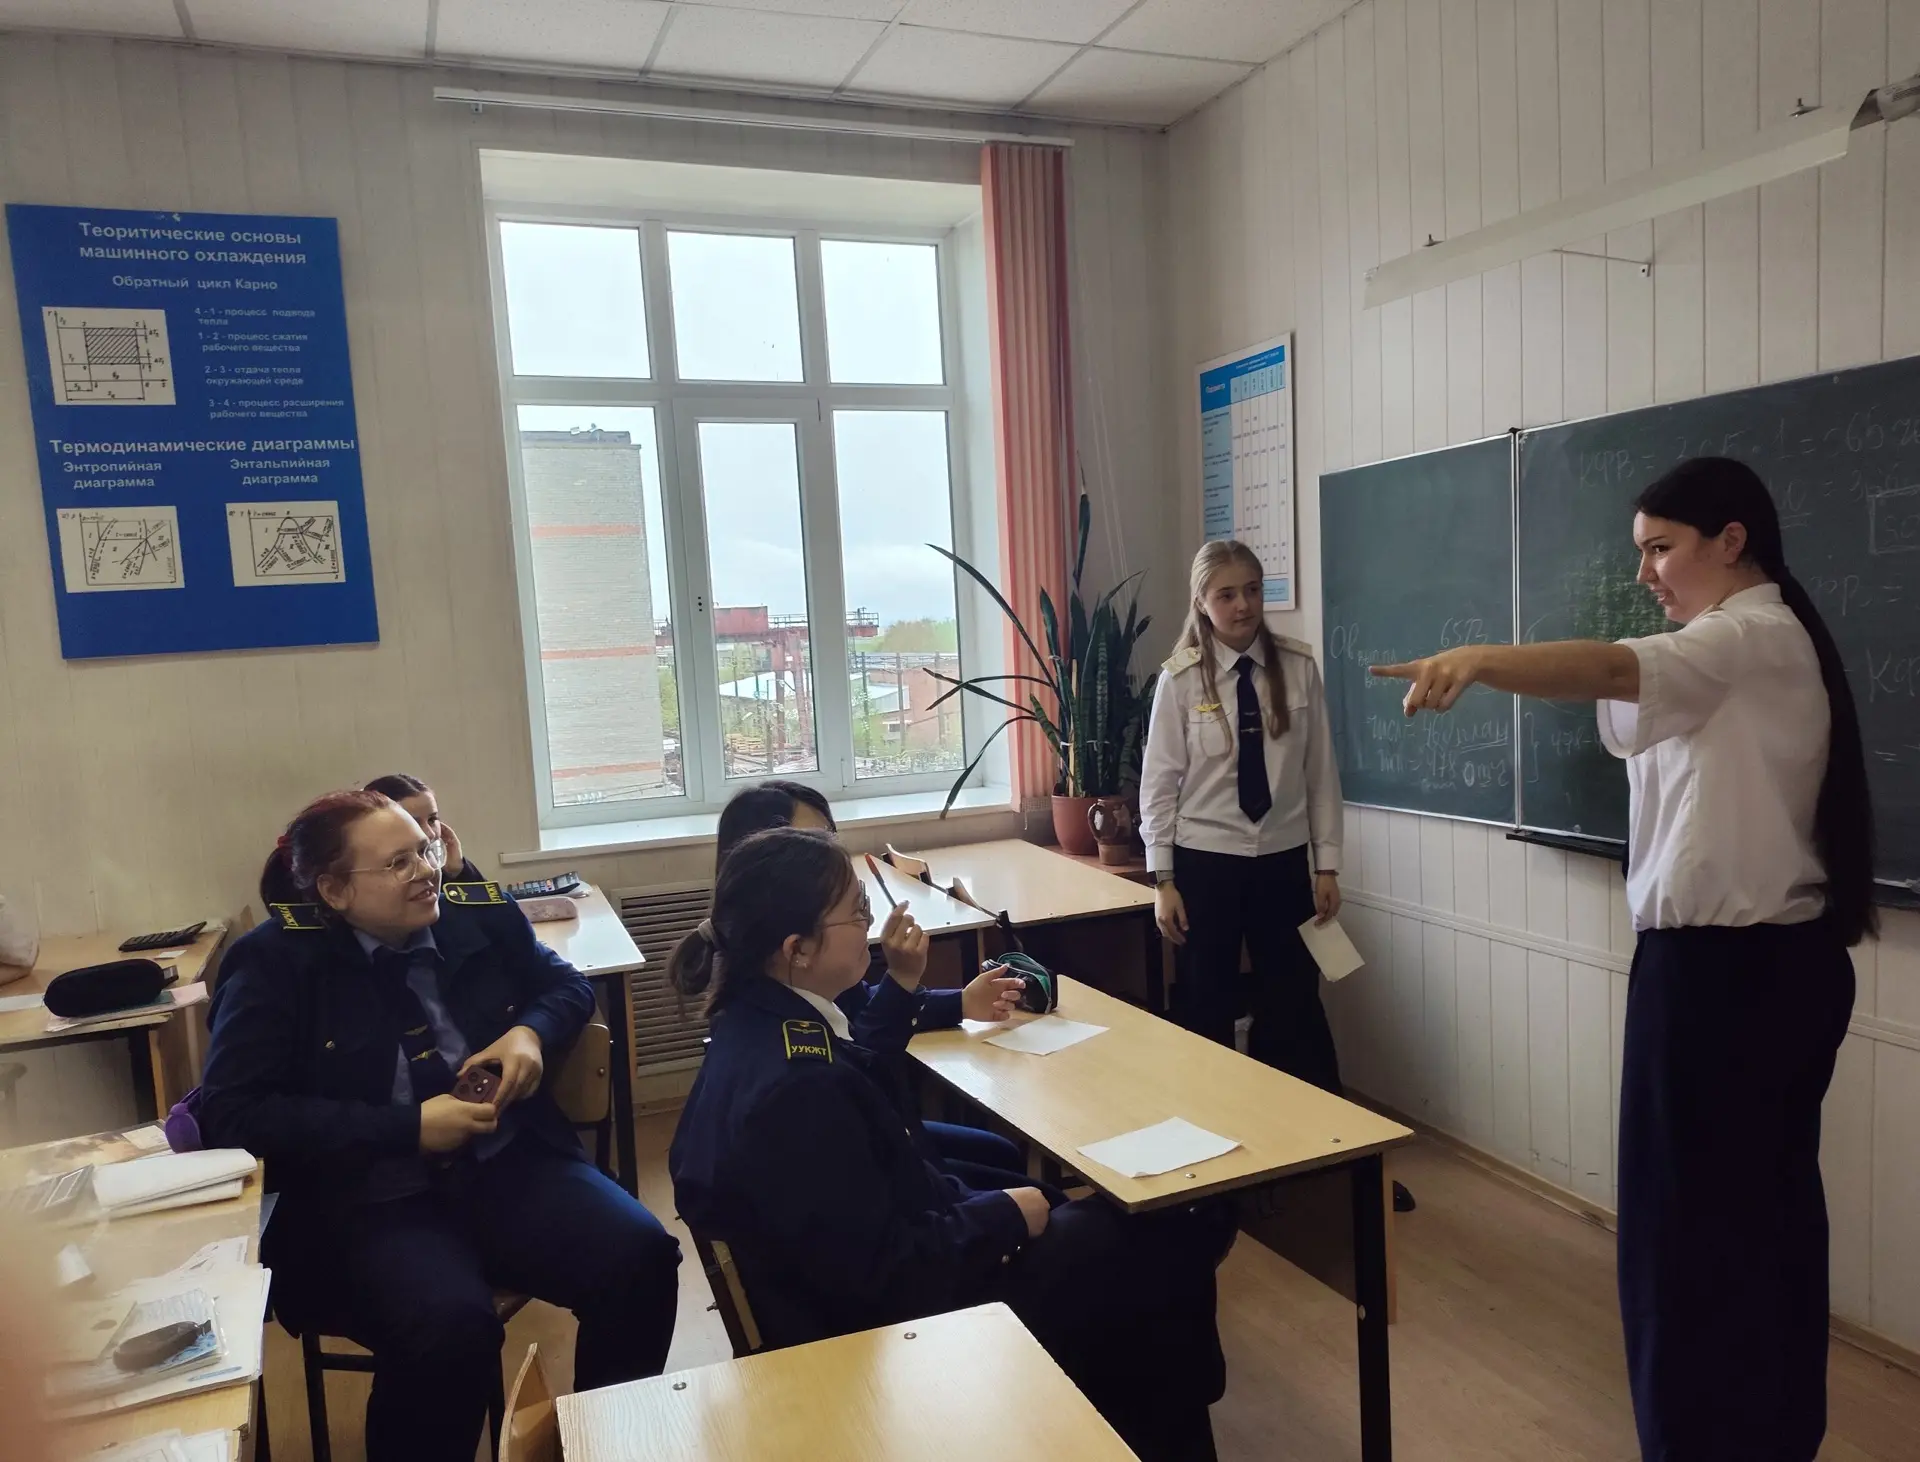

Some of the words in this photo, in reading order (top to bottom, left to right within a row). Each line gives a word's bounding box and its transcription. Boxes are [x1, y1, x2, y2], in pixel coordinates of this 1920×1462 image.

[78, 221, 226, 242] Теоритические
[230, 229, 301, 245] основы
[78, 245, 189, 261] машинного
[194, 249, 307, 267] охлаждения
[111, 274, 189, 289] Обратный
[197, 279, 231, 290] цикл
[235, 277, 278, 291] Карно
[194, 307, 201, 315] 4
[224, 308, 268, 318] процесс
[272, 309, 316, 318] подвода
[213, 331, 219, 340] 2
[227, 333, 270, 342] процесс
[272, 333, 308, 341] сжатия
[201, 343, 249, 353] рабочего
[251, 344, 301, 353] вещества
[204, 365, 210, 374] 2
[219, 365, 226, 374] 3
[234, 367, 270, 375] отдача
[205, 375, 272, 386] окружающей
[273, 377, 304, 386] среде
[208, 398, 215, 407] 3
[223, 399, 230, 407] 4
[238, 400, 281, 409] процесс
[282, 400, 345, 409] расширения
[209, 410, 257, 420] рабочего
[259, 410, 308, 419] вещества
[49, 438, 247, 456] Термодинамические
[251, 437, 355, 453] диаграммы
[63, 460, 162, 474] Энтропийная
[229, 457, 330, 470] Энтальпийная
[73, 477, 155, 490] диаграмма
[242, 473, 319, 487] диаграмма
[791, 1045, 827, 1056] УУКЖТ
